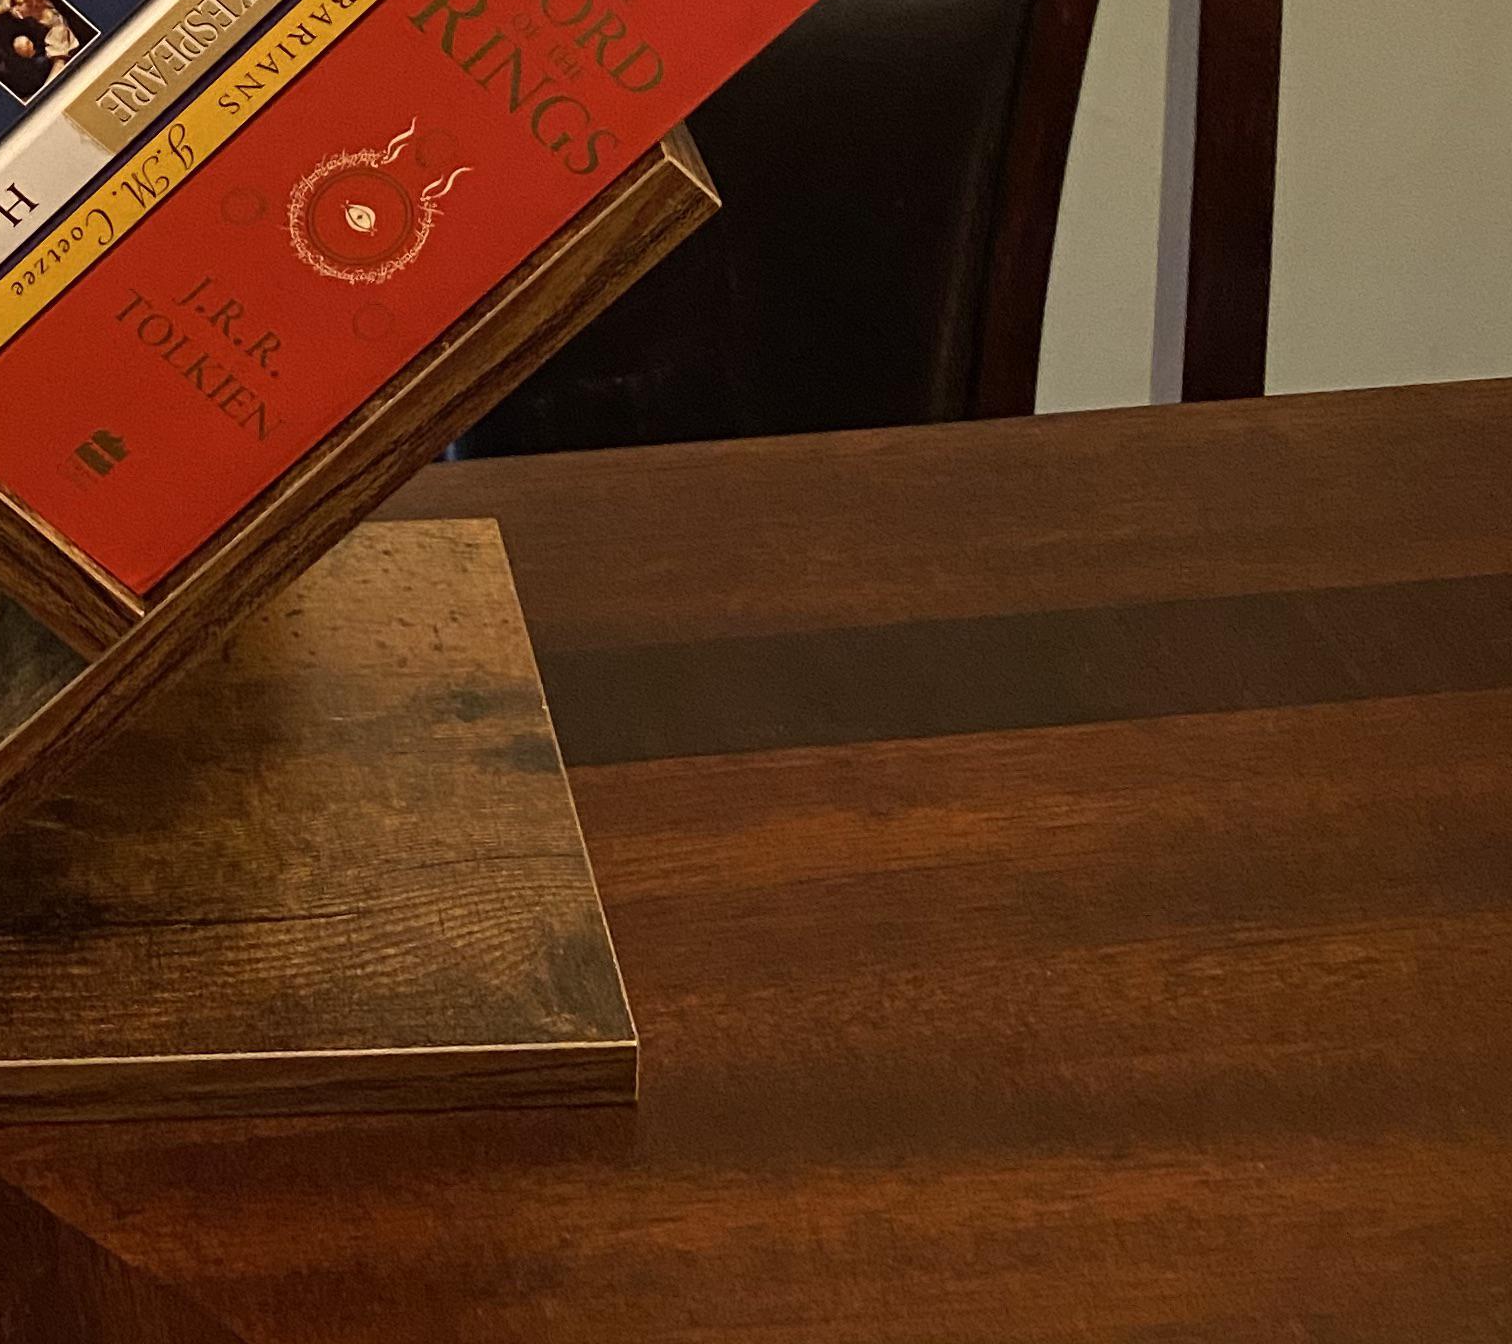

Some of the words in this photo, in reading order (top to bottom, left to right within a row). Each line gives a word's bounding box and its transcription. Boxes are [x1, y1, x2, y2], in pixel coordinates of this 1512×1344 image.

[97, 123, 214, 216] J.M.
[10, 208, 114, 296] Coetzee
[114, 280, 277, 451] TOLKIEN
[179, 273, 289, 387] J.R.R.
